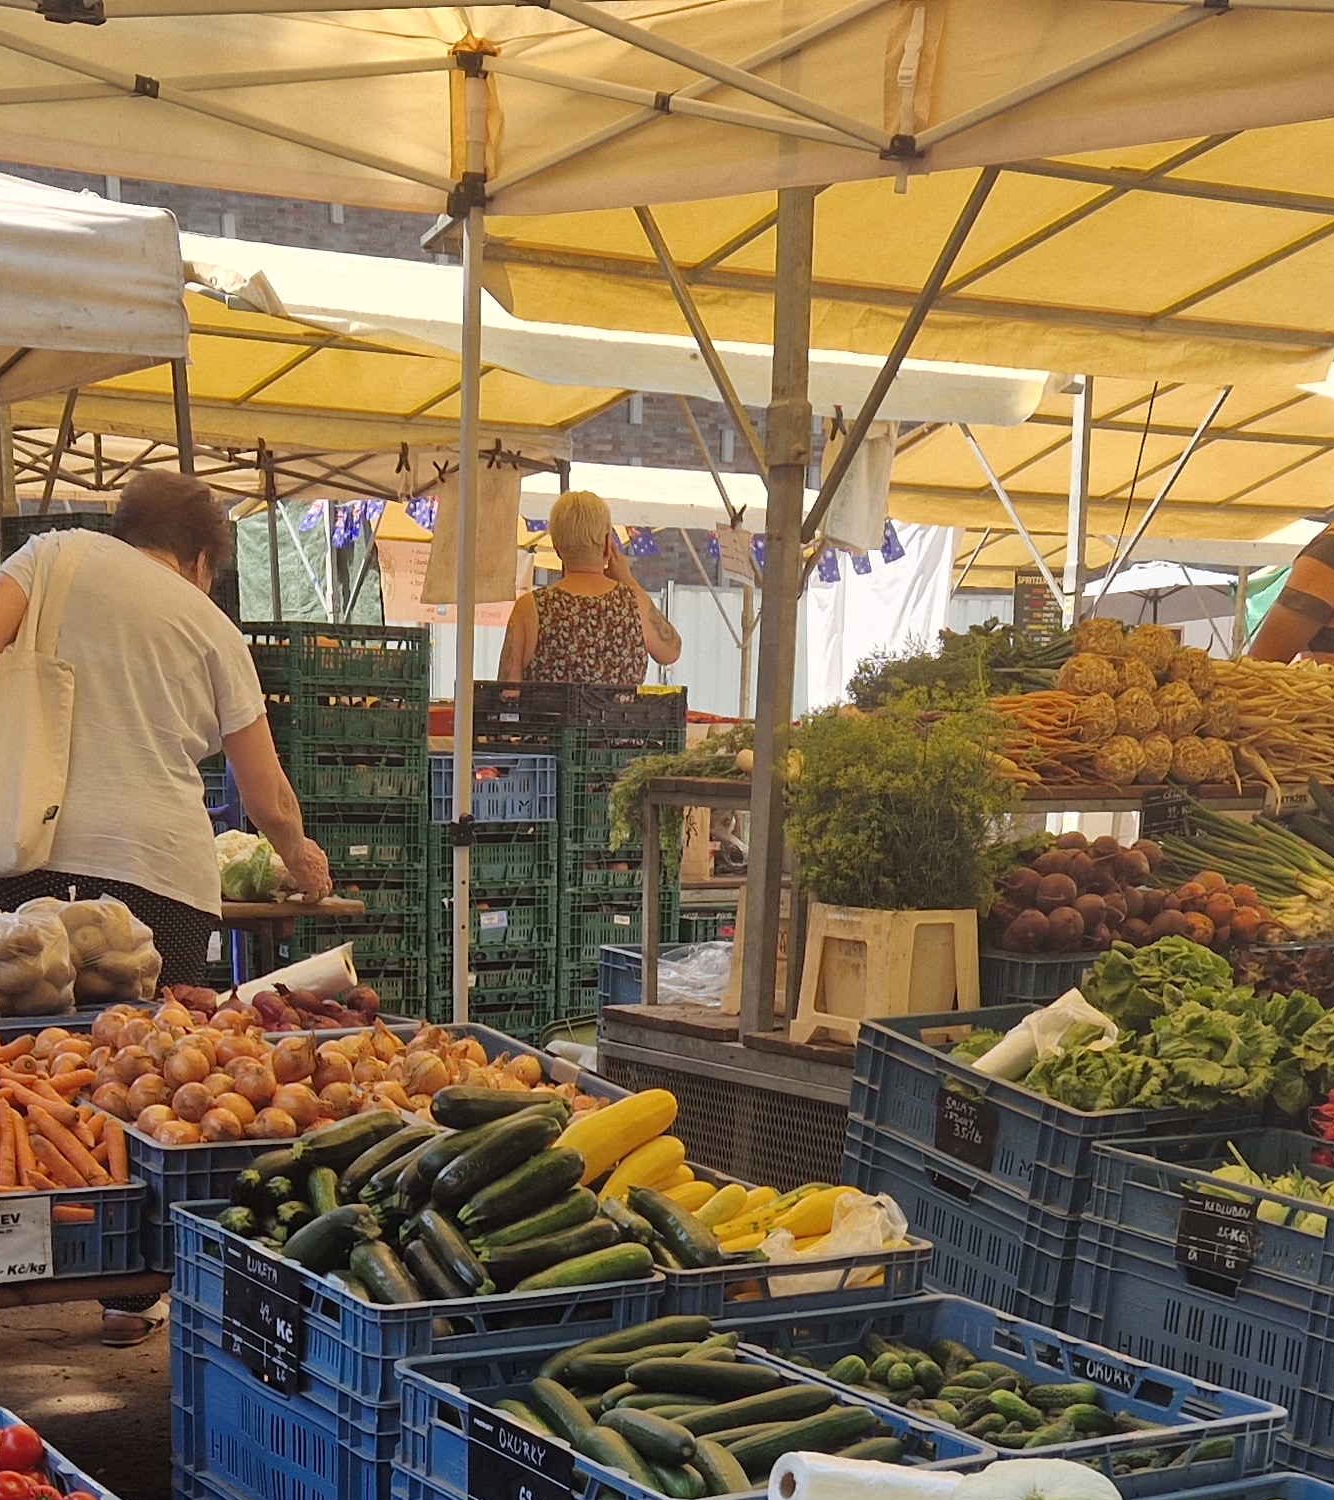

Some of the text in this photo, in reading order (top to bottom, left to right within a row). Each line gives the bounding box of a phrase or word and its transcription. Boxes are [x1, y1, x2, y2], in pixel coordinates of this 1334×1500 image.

[1017, 576, 1049, 585] SPRITZE
[7, 1263, 47, 1277] Kč/kg
[276, 1317, 294, 1344] Kč
[1086, 1359, 1137, 1389] OKURK
[499, 1427, 546, 1467] OKURKY
